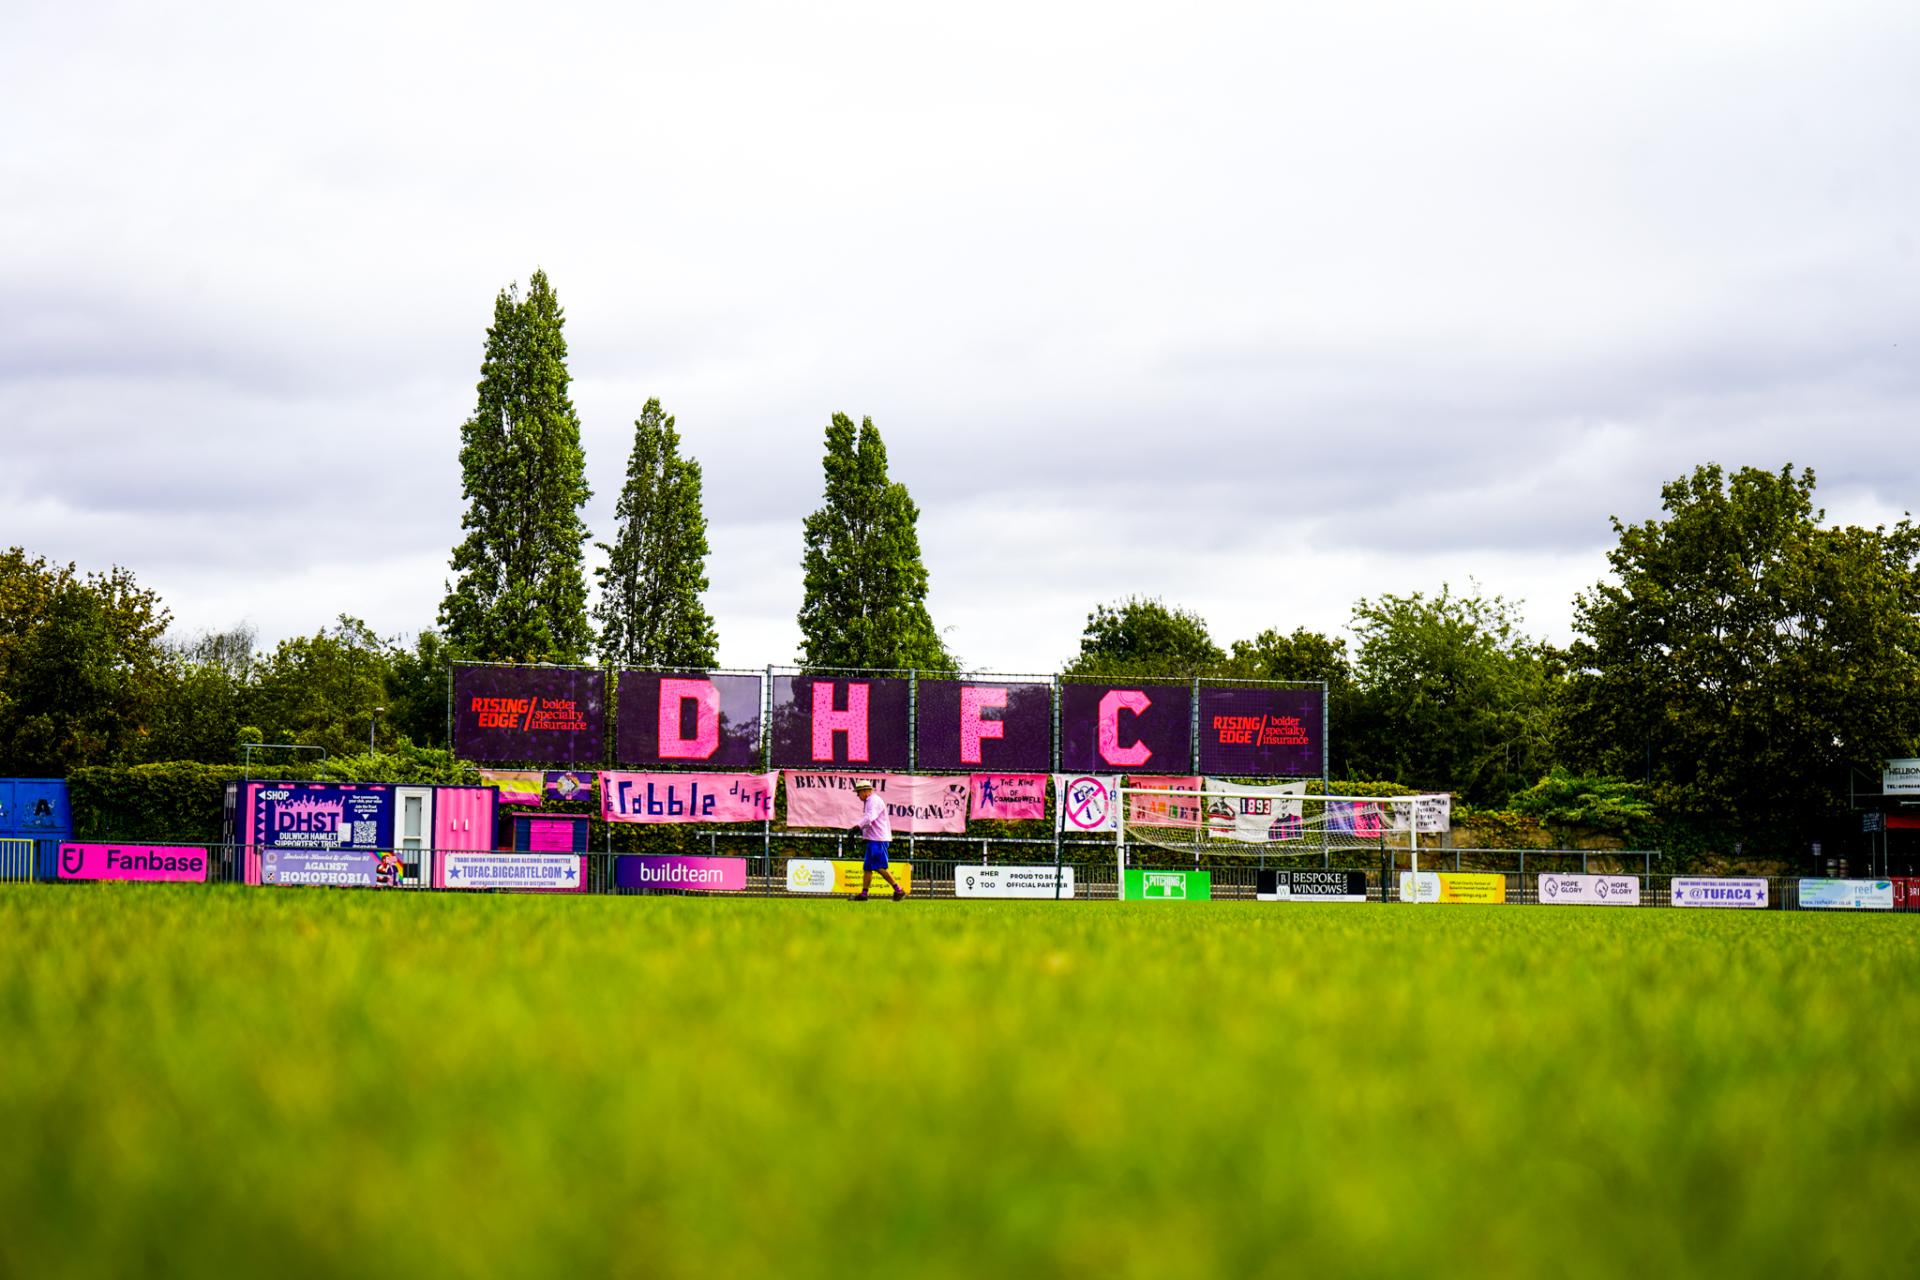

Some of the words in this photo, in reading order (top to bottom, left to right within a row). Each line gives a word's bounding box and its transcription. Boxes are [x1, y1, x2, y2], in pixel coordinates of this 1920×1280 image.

[471, 696, 529, 713] RISING
[542, 698, 577, 709] bolder
[478, 713, 519, 728] EDGE
[535, 709, 584, 720] specialty
[1271, 716, 1301, 726] bolder
[531, 719, 588, 730] insurance
[658, 677, 720, 760] D
[811, 681, 869, 762] H
[960, 686, 1008, 764] F
[1098, 689, 1153, 766] C
[1213, 715, 1260, 730] RISING
[1219, 730, 1252, 744] EDGE
[1265, 726, 1306, 736] specialty
[1263, 735, 1309, 745] insurance
[795, 775, 887, 792] BENVENTI
[267, 791, 290, 800] SHOP
[618, 781, 715, 816] rabble
[887, 803, 944, 820] TOSCANA
[1241, 797, 1271, 815] 1893
[279, 811, 340, 831] DHST
[279, 832, 310, 840] DULWICH
[107, 850, 203, 872] Fanbase
[304, 862, 349, 871] AGAINST
[280, 871, 371, 883] HOMOPHOBIA
[462, 865, 562, 878] TUFAC.BIGCARTEL.COM
[640, 862, 723, 883] buildteam
[1293, 872, 1342, 883] BESPOKE
[1293, 884, 1342, 894] WINDOWS
[1689, 887, 1752, 900] @TUFAC4
[1855, 884, 1873, 894] reef
